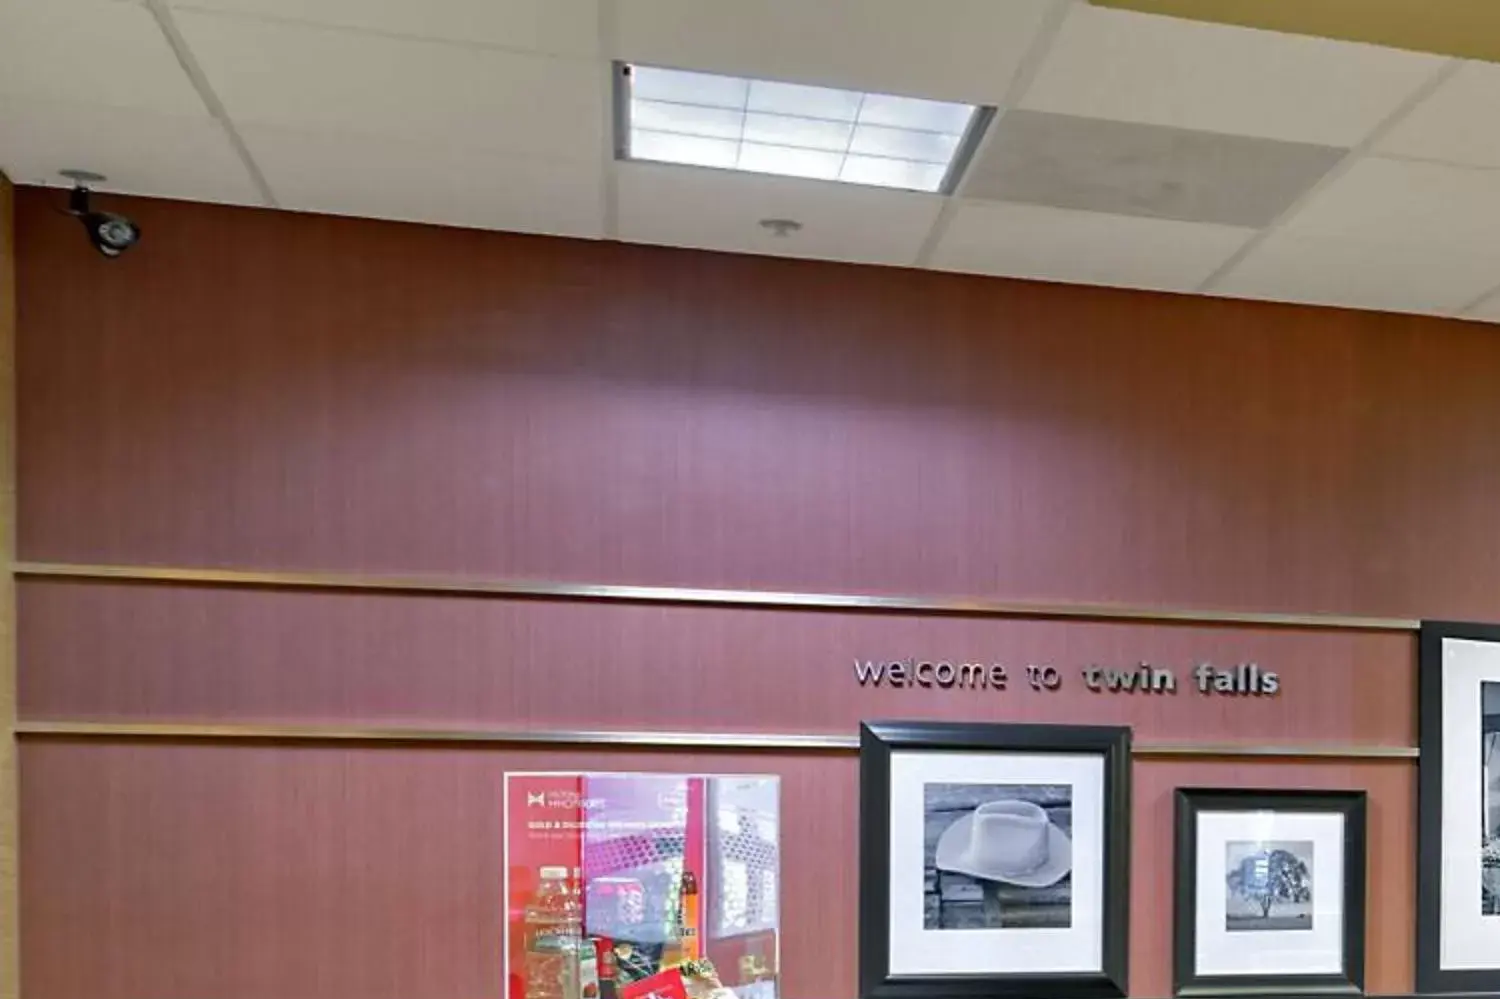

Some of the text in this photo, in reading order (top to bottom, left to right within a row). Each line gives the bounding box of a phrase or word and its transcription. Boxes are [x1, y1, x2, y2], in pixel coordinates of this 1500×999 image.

[853, 656, 1280, 695] welcome to twin falls
